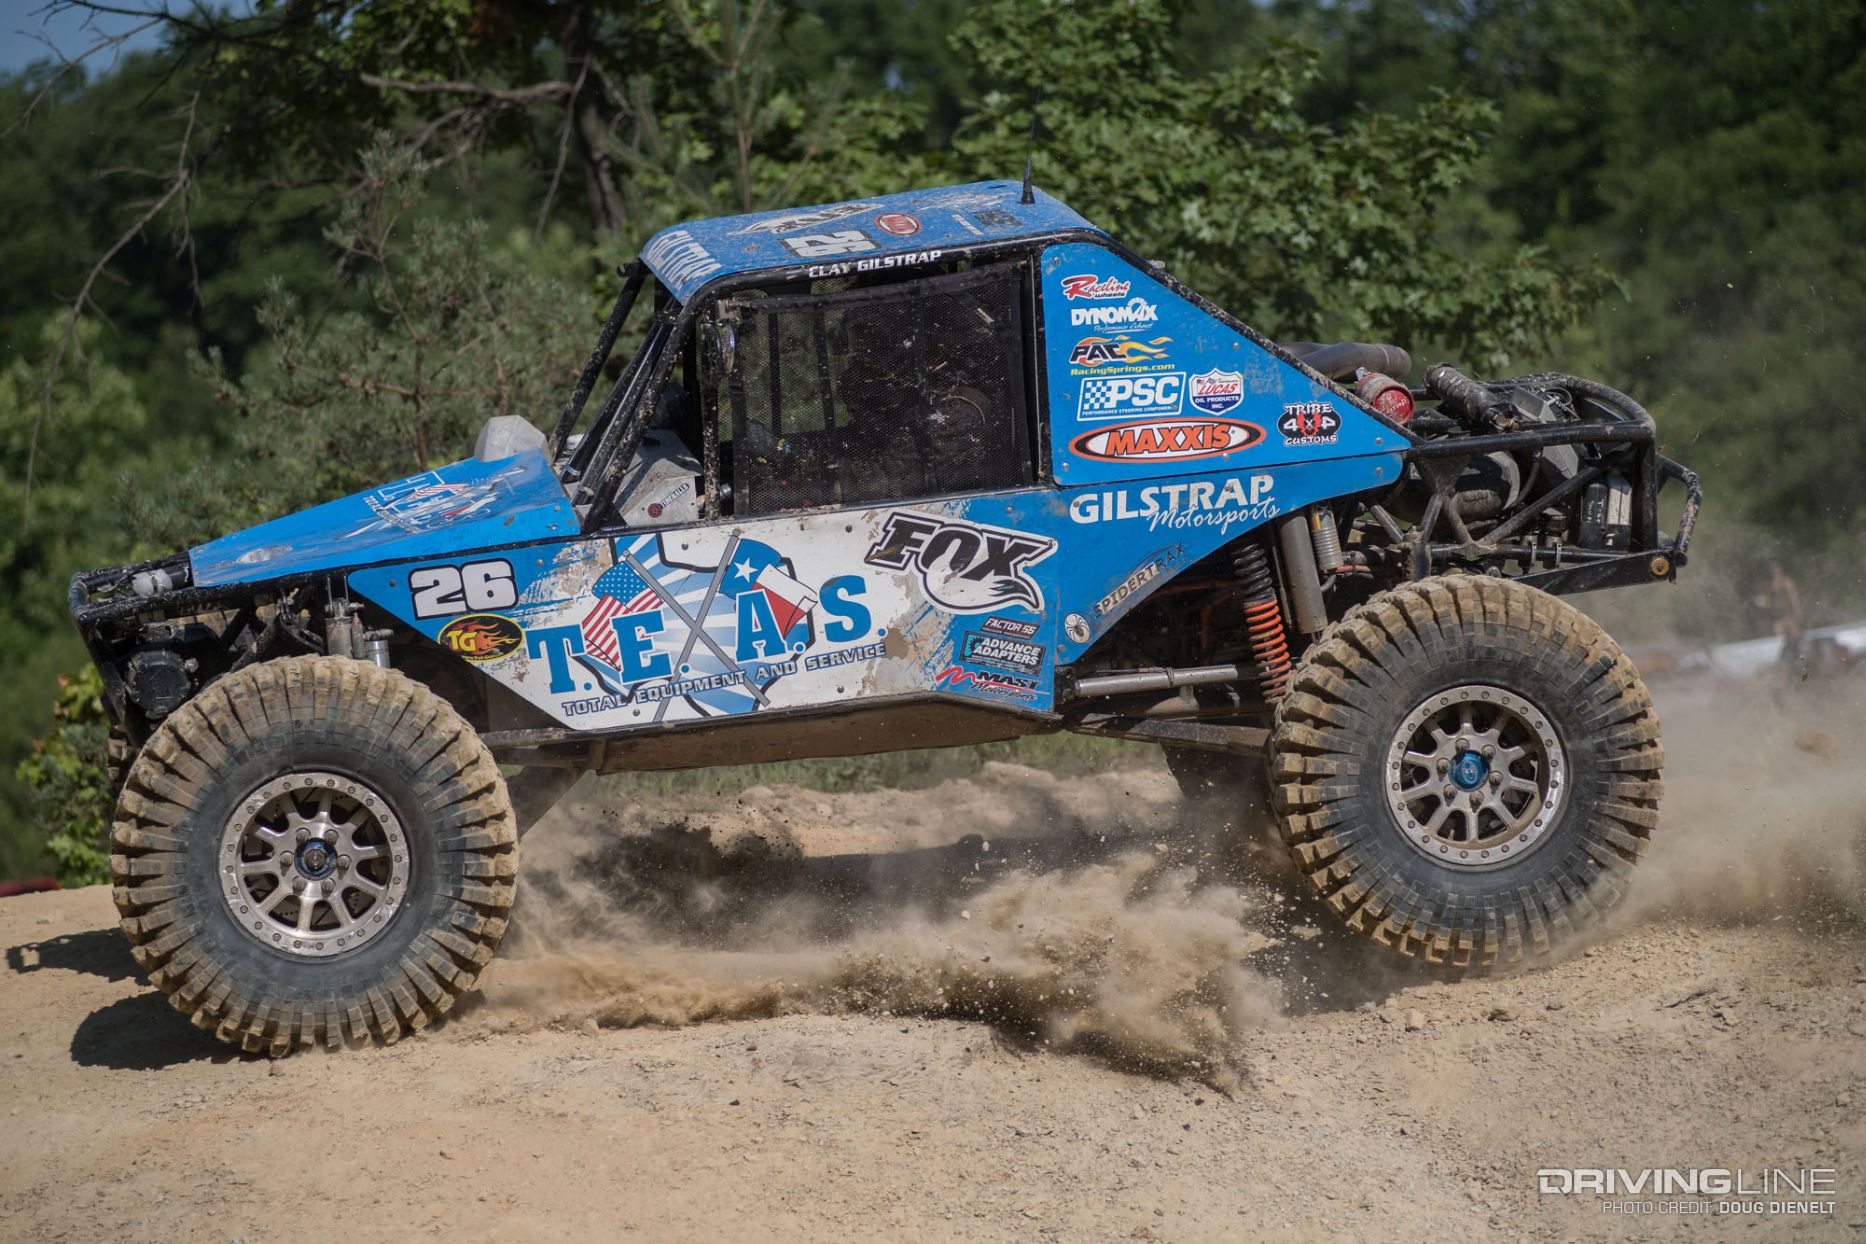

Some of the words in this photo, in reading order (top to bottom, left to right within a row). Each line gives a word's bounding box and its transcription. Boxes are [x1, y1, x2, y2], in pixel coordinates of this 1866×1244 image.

[809, 262, 851, 278] CLAY
[857, 250, 942, 272] GILSTRAP
[1071, 298, 1158, 326] DYNOMAX
[1069, 343, 1127, 364] PAC
[1071, 364, 1176, 376] RacingSprings.com
[1105, 376, 1180, 409] PSC
[1198, 383, 1239, 395] LUCAS
[1207, 395, 1239, 403] PRODUCTS
[1082, 408, 1118, 416] PERFORMANCE
[1144, 405, 1179, 413] COMPONEN
[1285, 402, 1333, 416] TRIBE
[1105, 424, 1232, 456] MAXXIS
[1284, 433, 1338, 446] CUSTOMS
[1070, 475, 1274, 524] GILSTRAP
[1150, 498, 1280, 536] Motorsports
[866, 512, 1058, 598] FOX
[408, 557, 519, 620] 26
[1093, 542, 1185, 619] SPIDERTRAX
[985, 618, 1021, 632] FACTOR
[446, 630, 478, 652] TG
[981, 638, 1041, 656] ADVANCE
[973, 645, 1039, 666] ADAPTERS
[562, 692, 631, 716] TOTAL
[634, 670, 747, 702] EQUIPMENT
[755, 662, 797, 680] AND
[804, 643, 887, 671] SERVICE
[977, 670, 1040, 690] MAST
